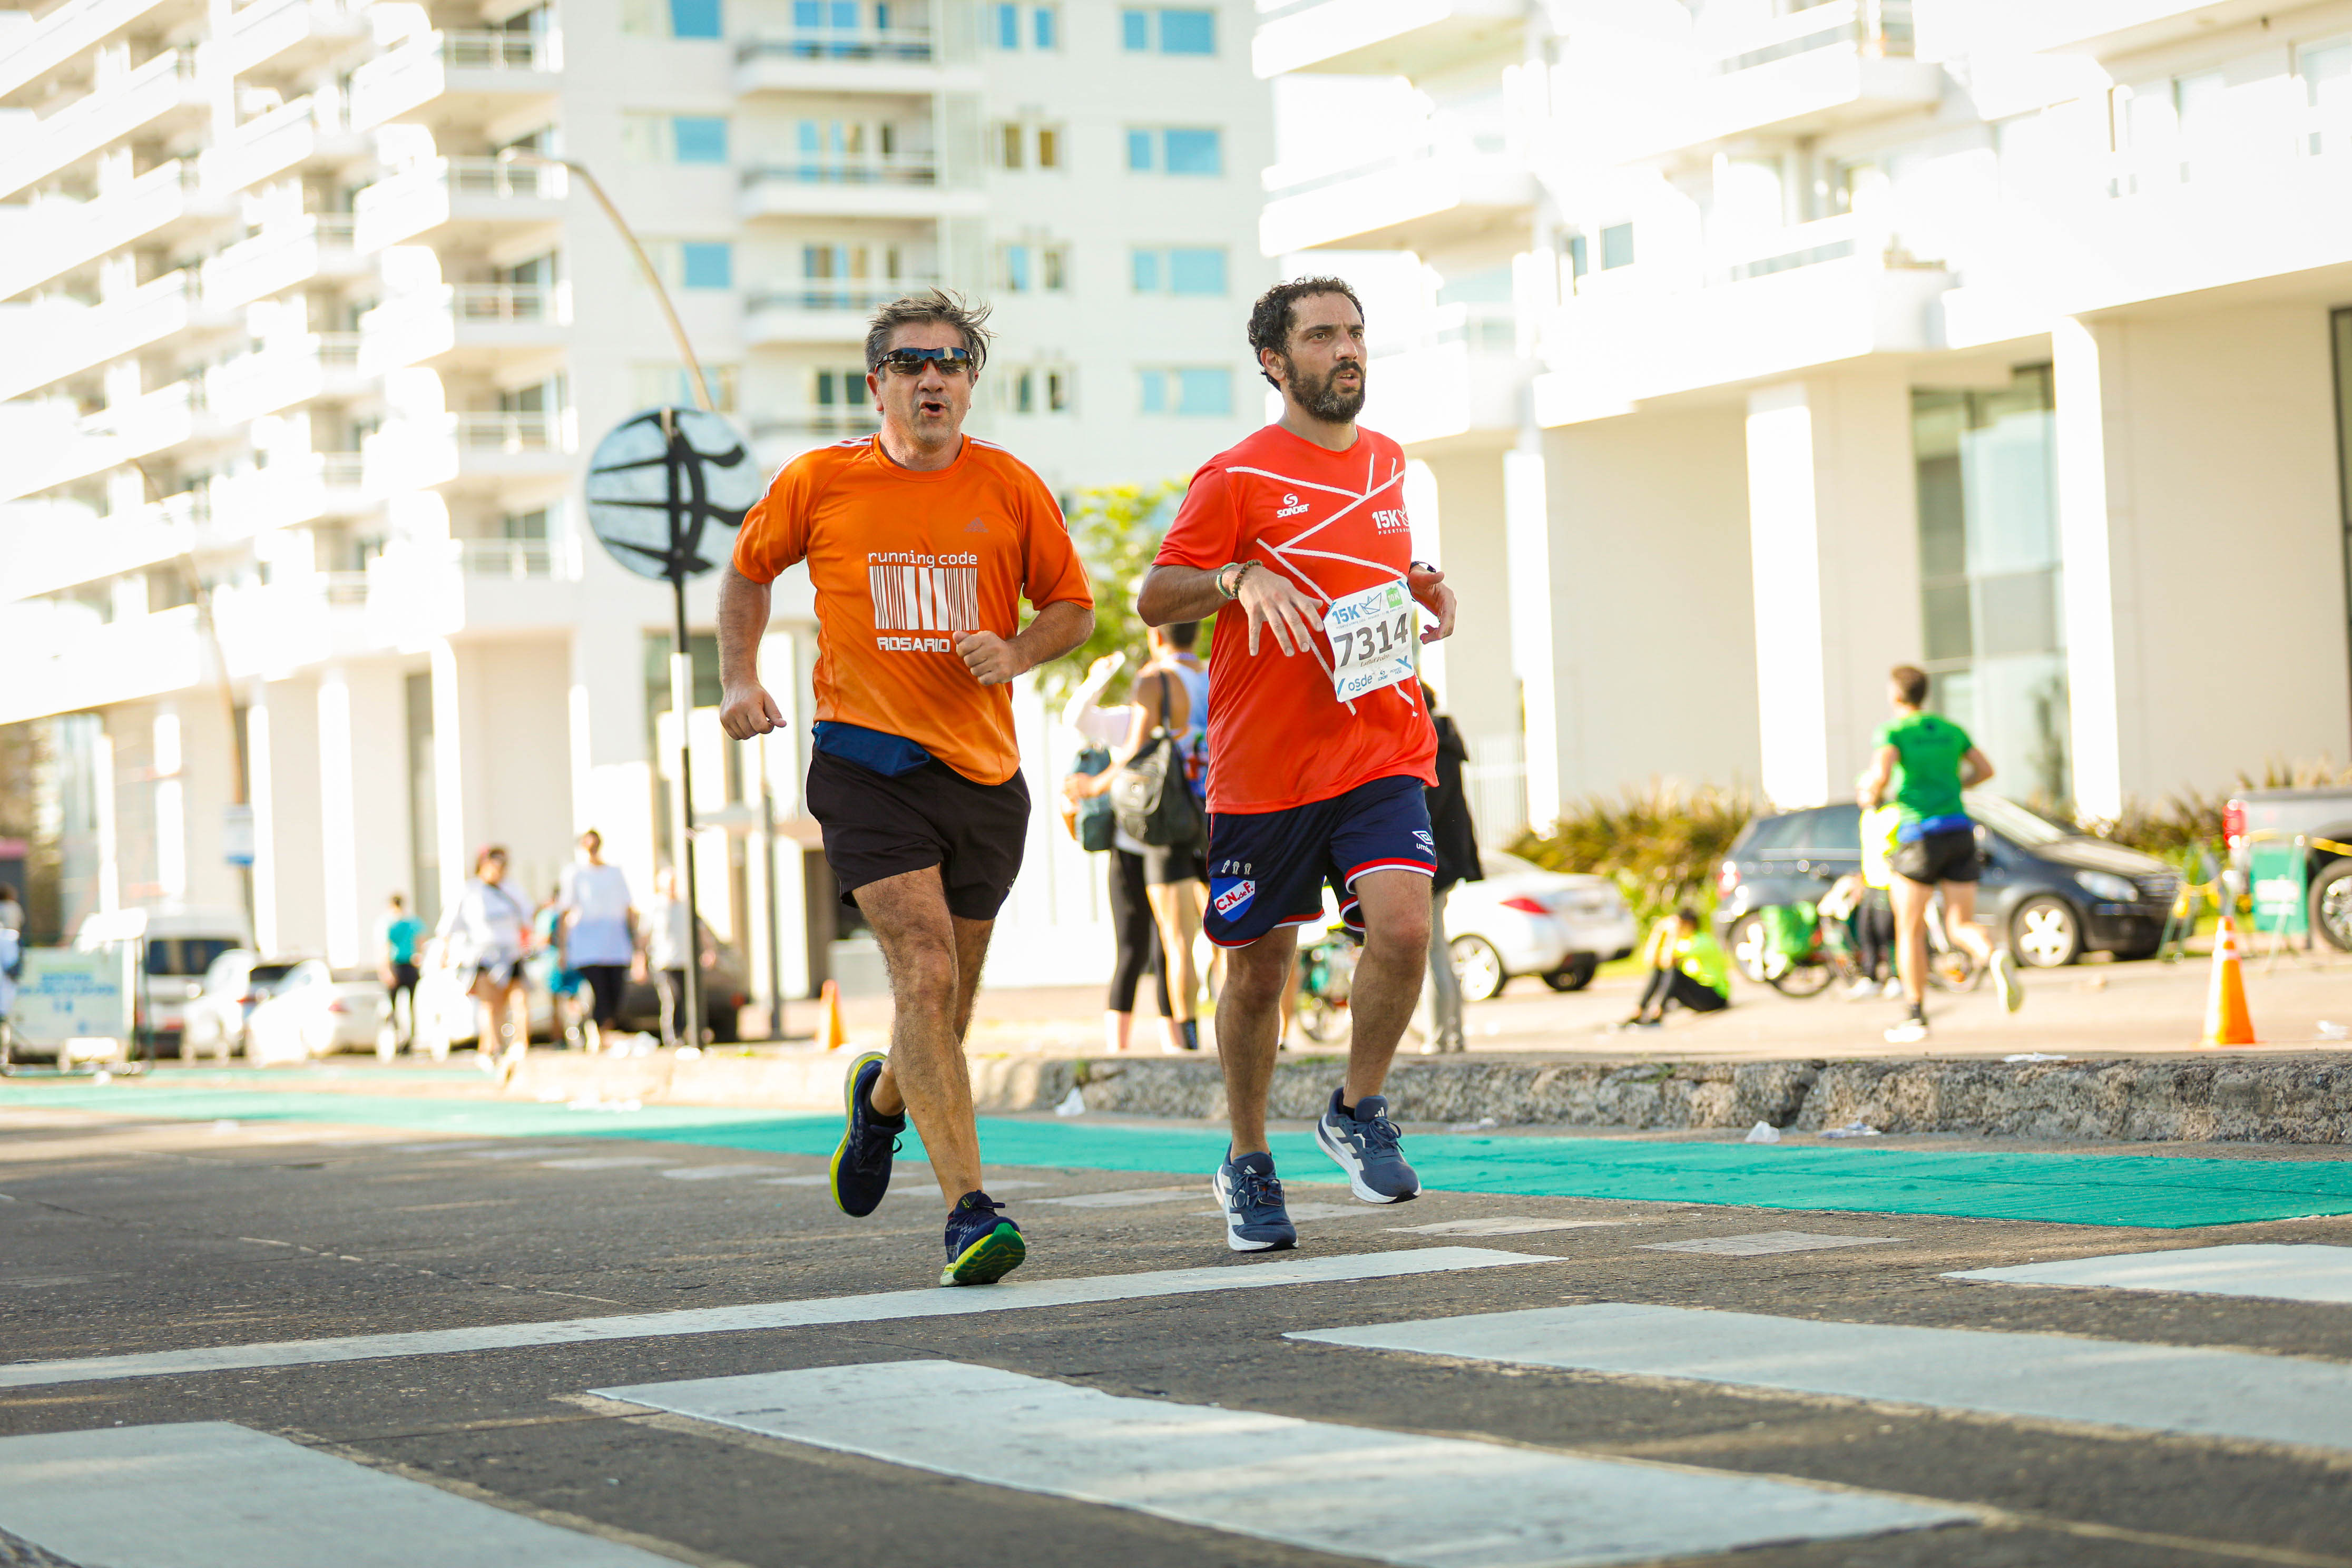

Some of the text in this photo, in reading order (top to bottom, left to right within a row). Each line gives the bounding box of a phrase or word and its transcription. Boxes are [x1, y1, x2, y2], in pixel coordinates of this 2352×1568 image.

[1371, 509, 1401, 529] 15K
[868, 550, 977, 568] running code
[1388, 592, 1400, 602] 10K
[1332, 604, 1360, 624] 15K
[876, 636, 950, 653] ROSARIO
[1333, 612, 1408, 667] 7314
[1348, 674, 1373, 691] osde
